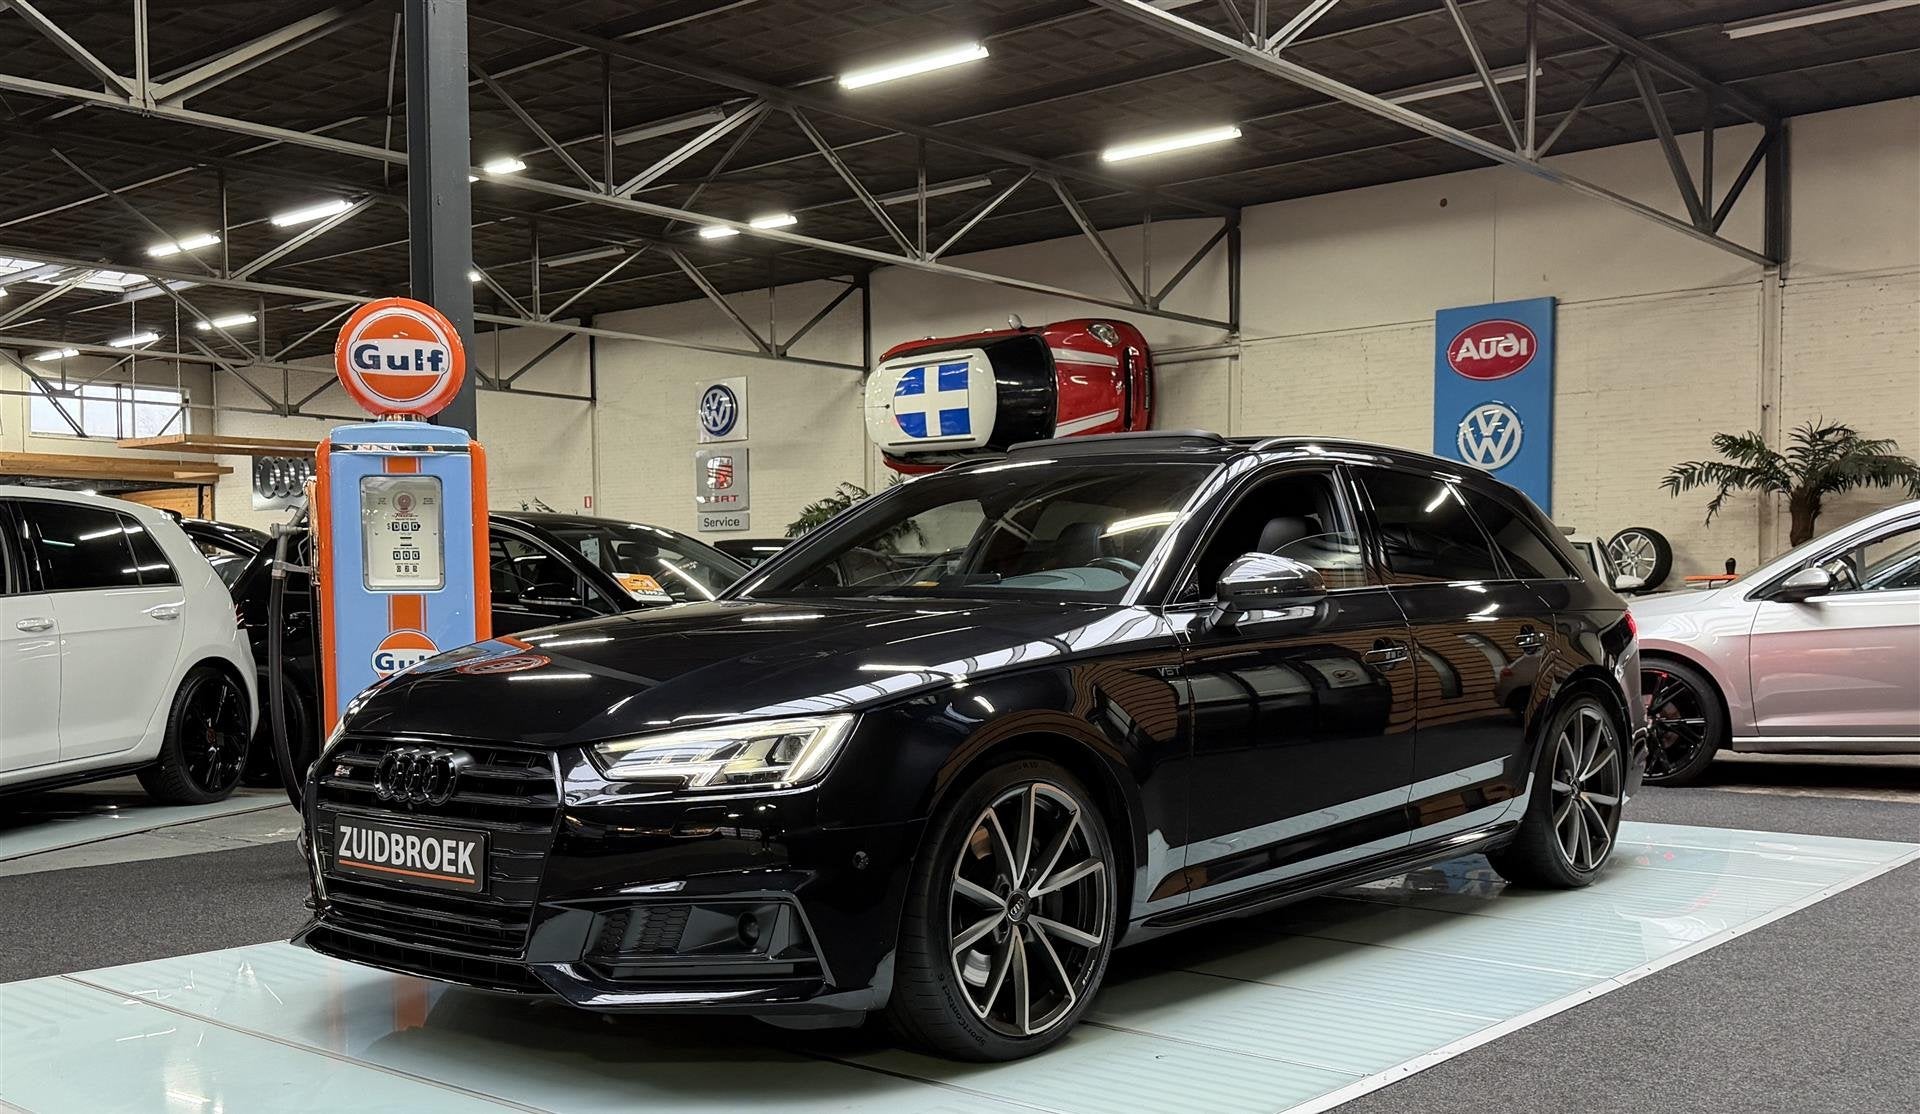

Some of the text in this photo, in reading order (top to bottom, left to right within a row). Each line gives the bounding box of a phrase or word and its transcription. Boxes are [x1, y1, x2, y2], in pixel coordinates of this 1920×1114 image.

[354, 344, 443, 371] Gulf
[704, 516, 740, 528] Service
[339, 825, 475, 875] ZUIDBROEK
